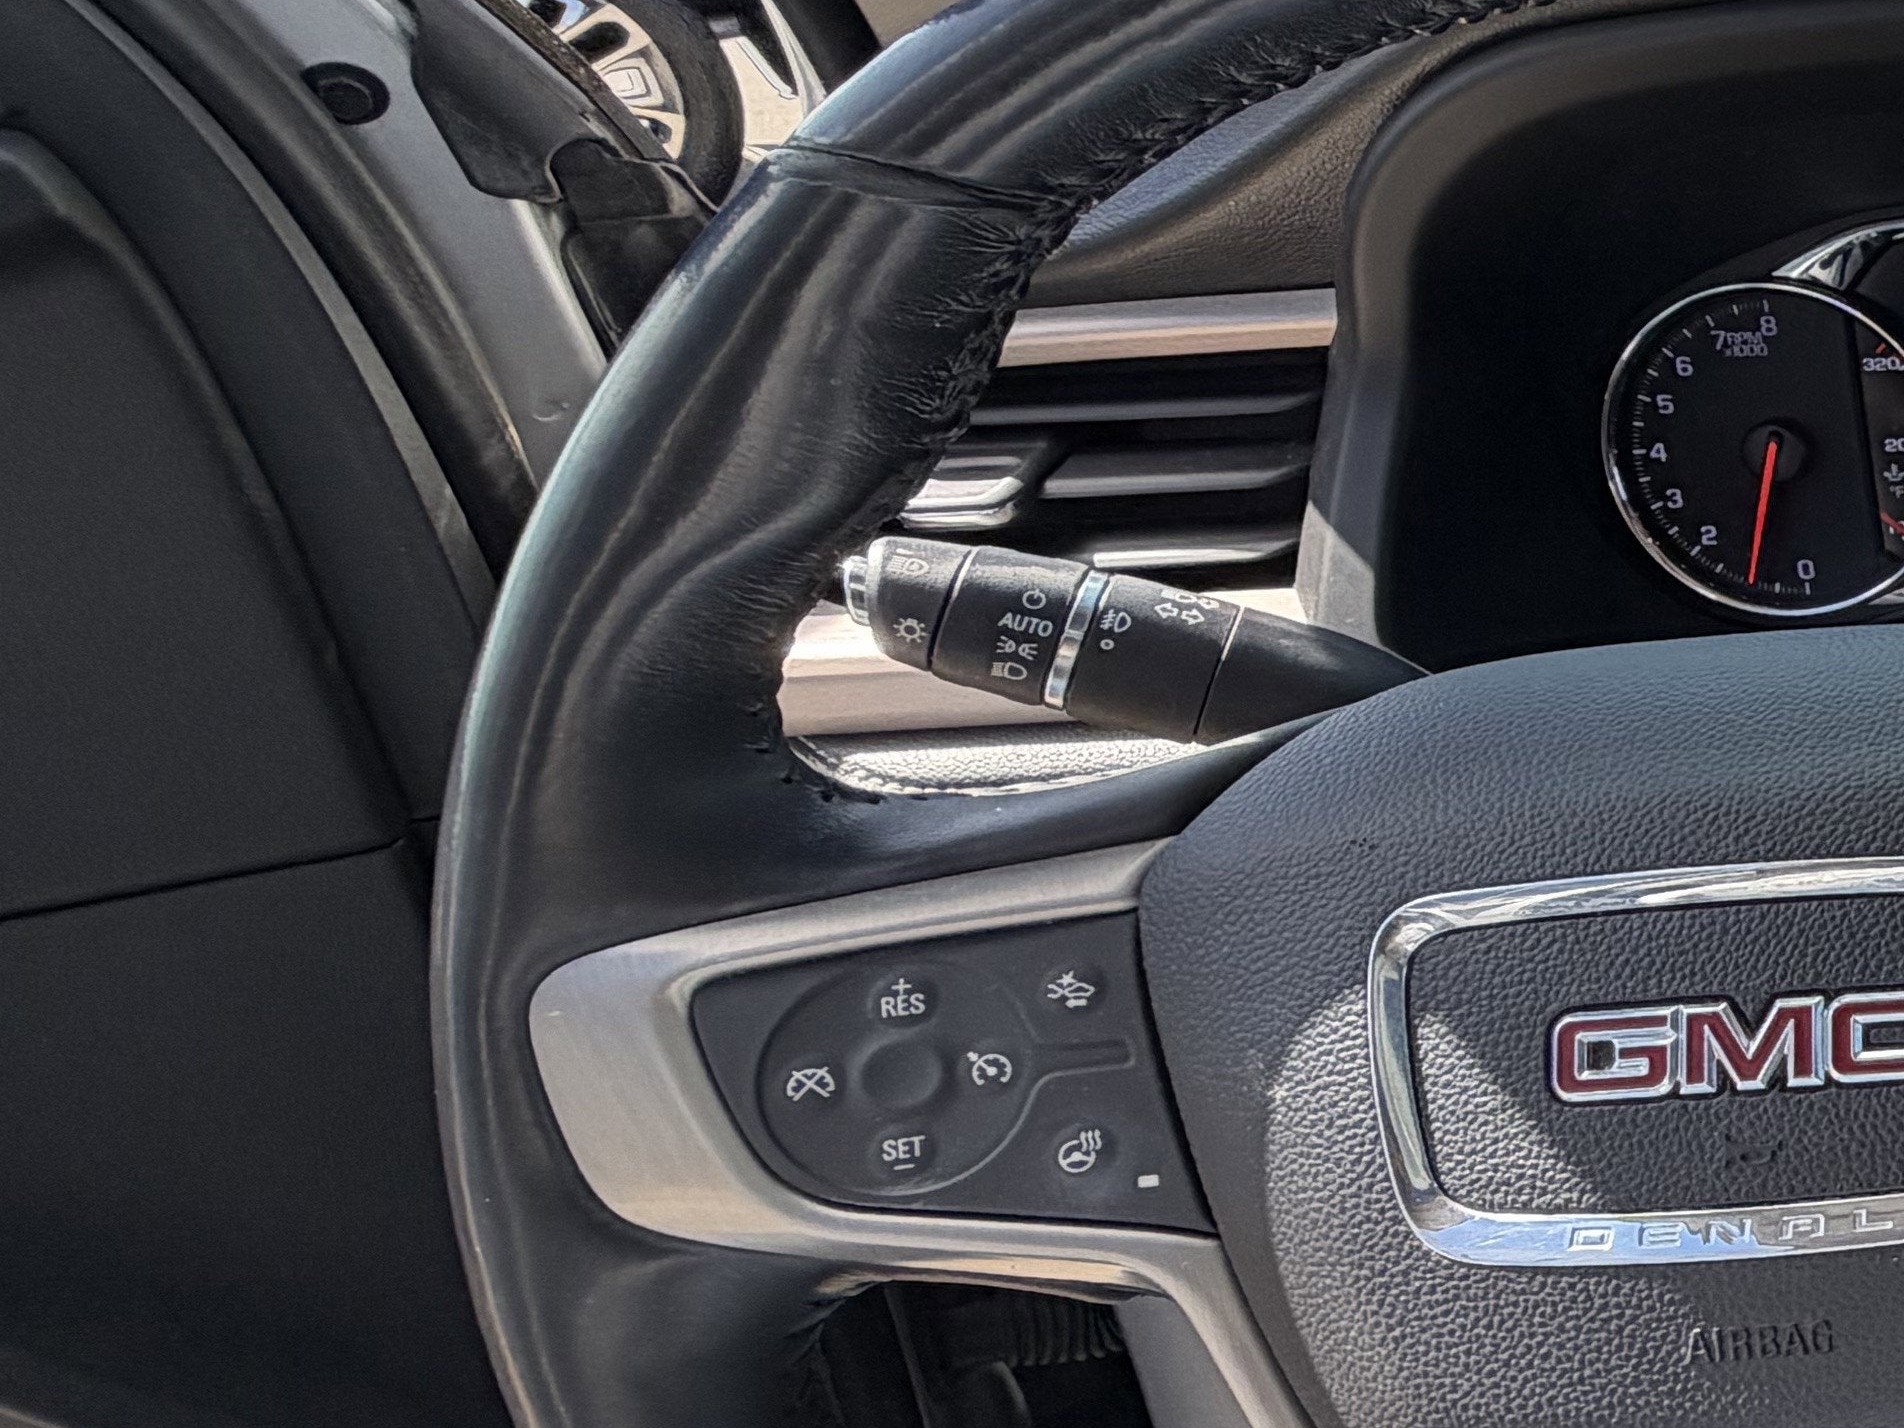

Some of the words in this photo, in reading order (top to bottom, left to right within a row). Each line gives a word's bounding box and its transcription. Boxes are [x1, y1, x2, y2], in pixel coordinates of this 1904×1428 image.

[1759, 315, 1778, 337] 8
[1711, 329, 1727, 351] 7
[1726, 331, 1763, 346] RPM
[1674, 356, 1694, 376] 6
[1862, 356, 1900, 372] 320
[1655, 394, 1675, 415] 5
[1649, 442, 1668, 463] 4
[1665, 489, 1684, 510] 3
[1700, 525, 1718, 546] 2
[1796, 559, 1816, 580] 0
[998, 611, 1054, 639] AUTO
[880, 993, 926, 1018] RES
[881, 1135, 926, 1162] SET
[1684, 1318, 1835, 1365] AIRBAG
